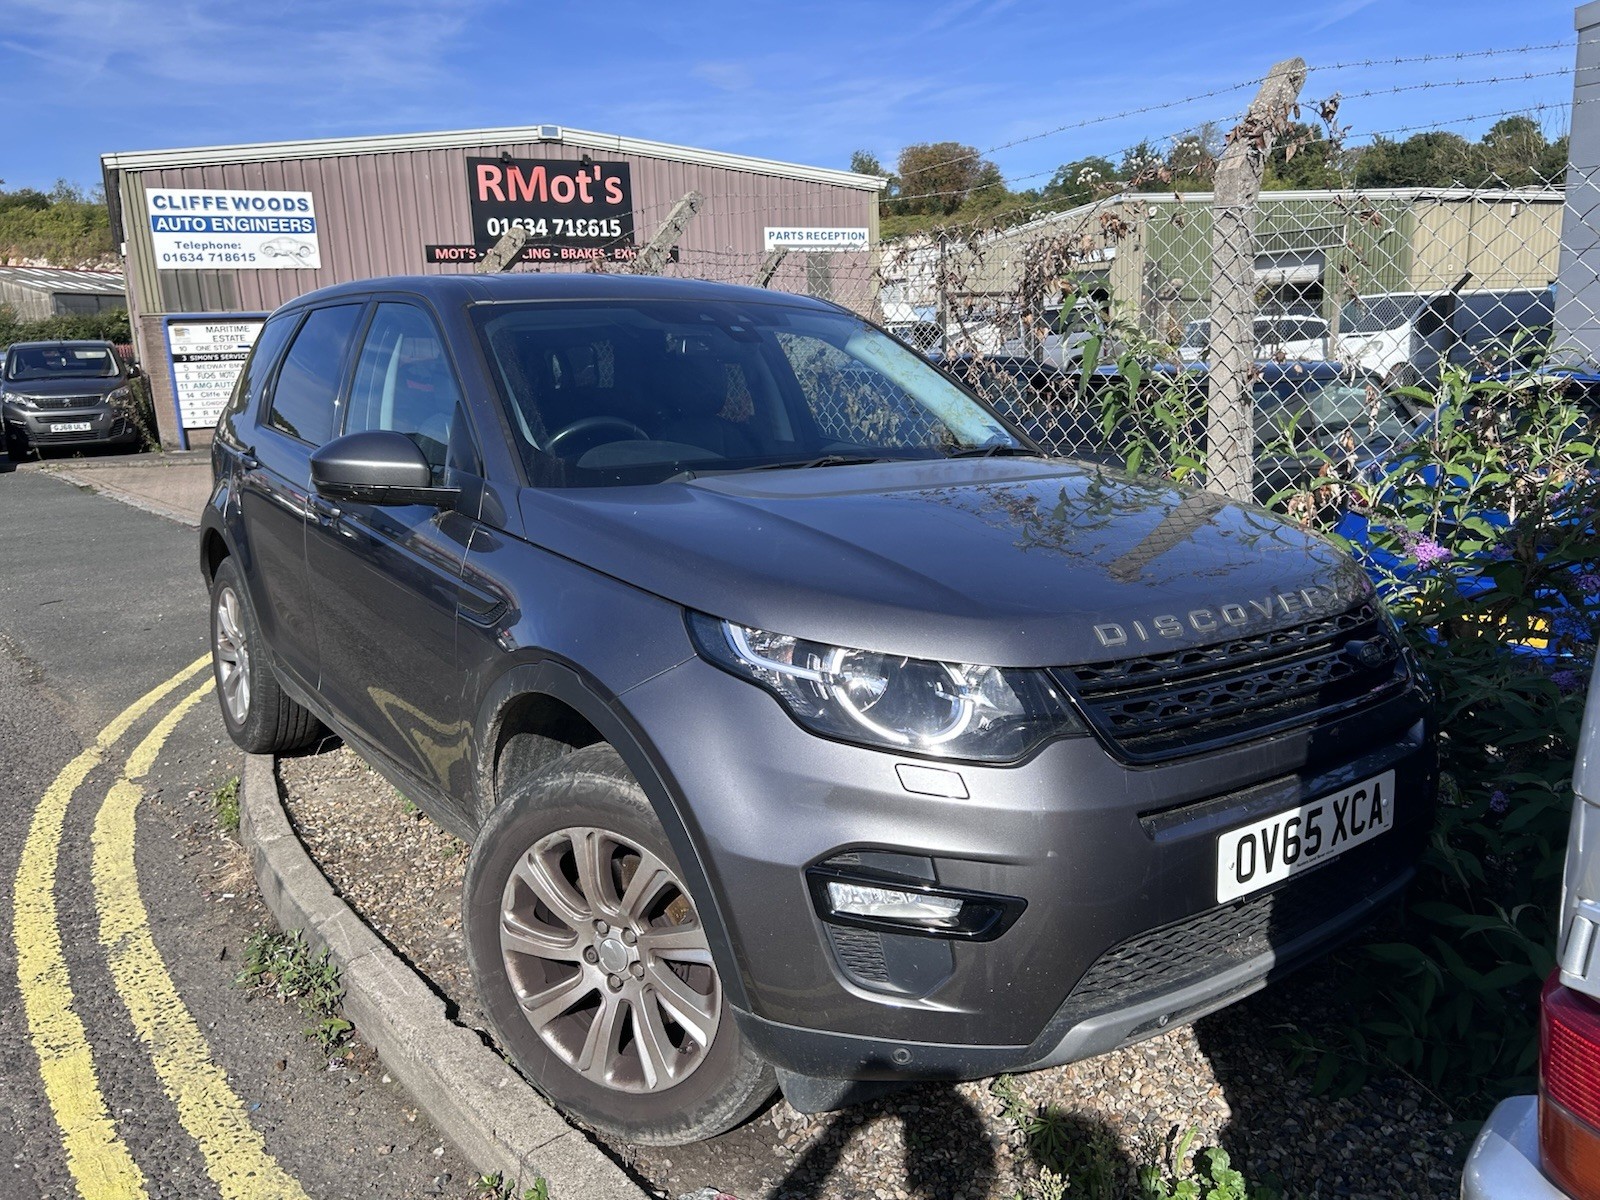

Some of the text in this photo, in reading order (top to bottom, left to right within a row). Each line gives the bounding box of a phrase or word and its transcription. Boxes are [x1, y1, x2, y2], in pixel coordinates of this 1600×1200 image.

[476, 164, 624, 204] RMot's
[153, 195, 310, 212] CLIFFE WOODS
[156, 217, 313, 232] AUTO ENGINEERS
[768, 231, 866, 241] PARTS RECEPTION
[174, 241, 242, 251] Telephone:
[163, 253, 256, 262] 01634 718615
[435, 248, 476, 260] MOT'S
[561, 248, 605, 259] BRAKES
[205, 325, 251, 333] MARITIME
[212, 334, 246, 343] ESTATE
[183, 364, 189, 372] 5
[1235, 782, 1383, 884] OV65 XCA
